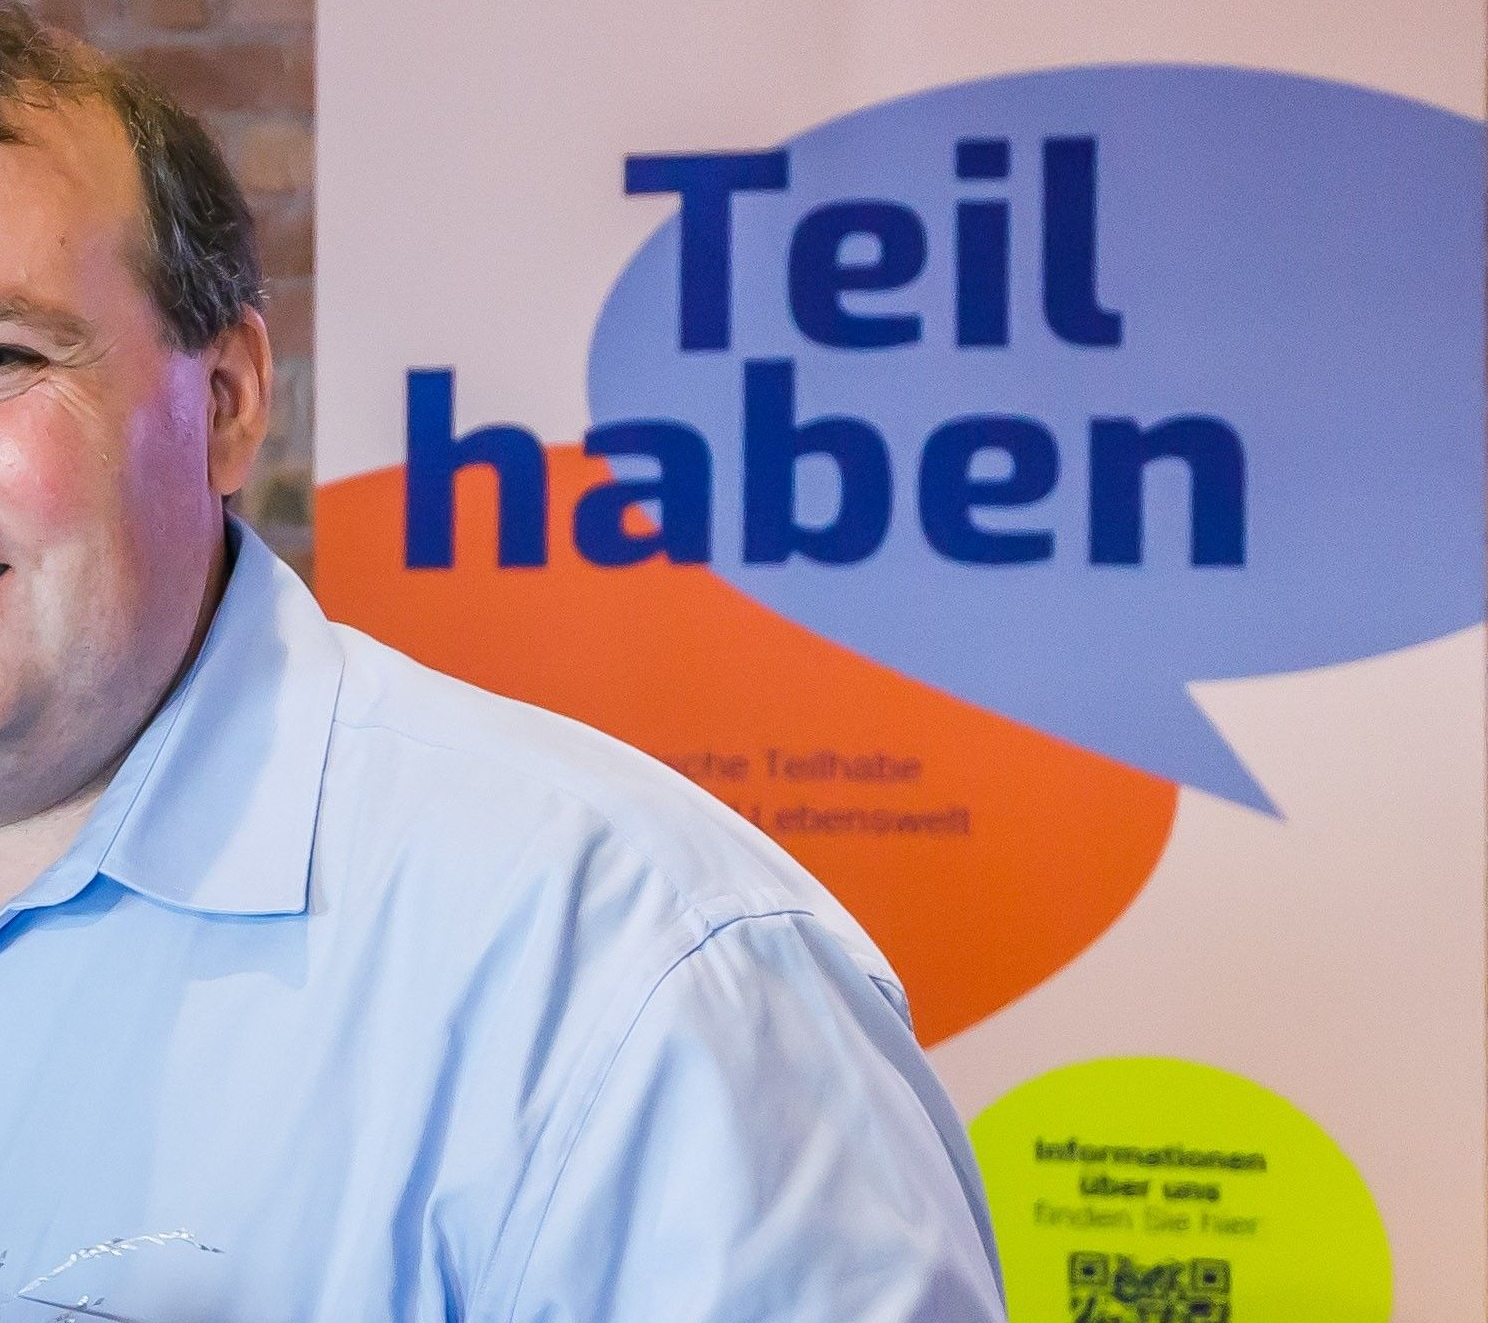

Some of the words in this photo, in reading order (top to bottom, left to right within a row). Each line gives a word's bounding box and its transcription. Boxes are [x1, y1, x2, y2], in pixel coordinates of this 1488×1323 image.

[624, 135, 1123, 352] Teil
[404, 358, 1247, 570] haben
[766, 748, 922, 783] Teilhabe
[1034, 1136, 1267, 1171] Informationen
[1078, 1167, 1149, 1198] über
[1162, 1181, 1221, 1202] uns
[1035, 1200, 1133, 1228] finden
[1142, 1204, 1191, 1231] Sie
